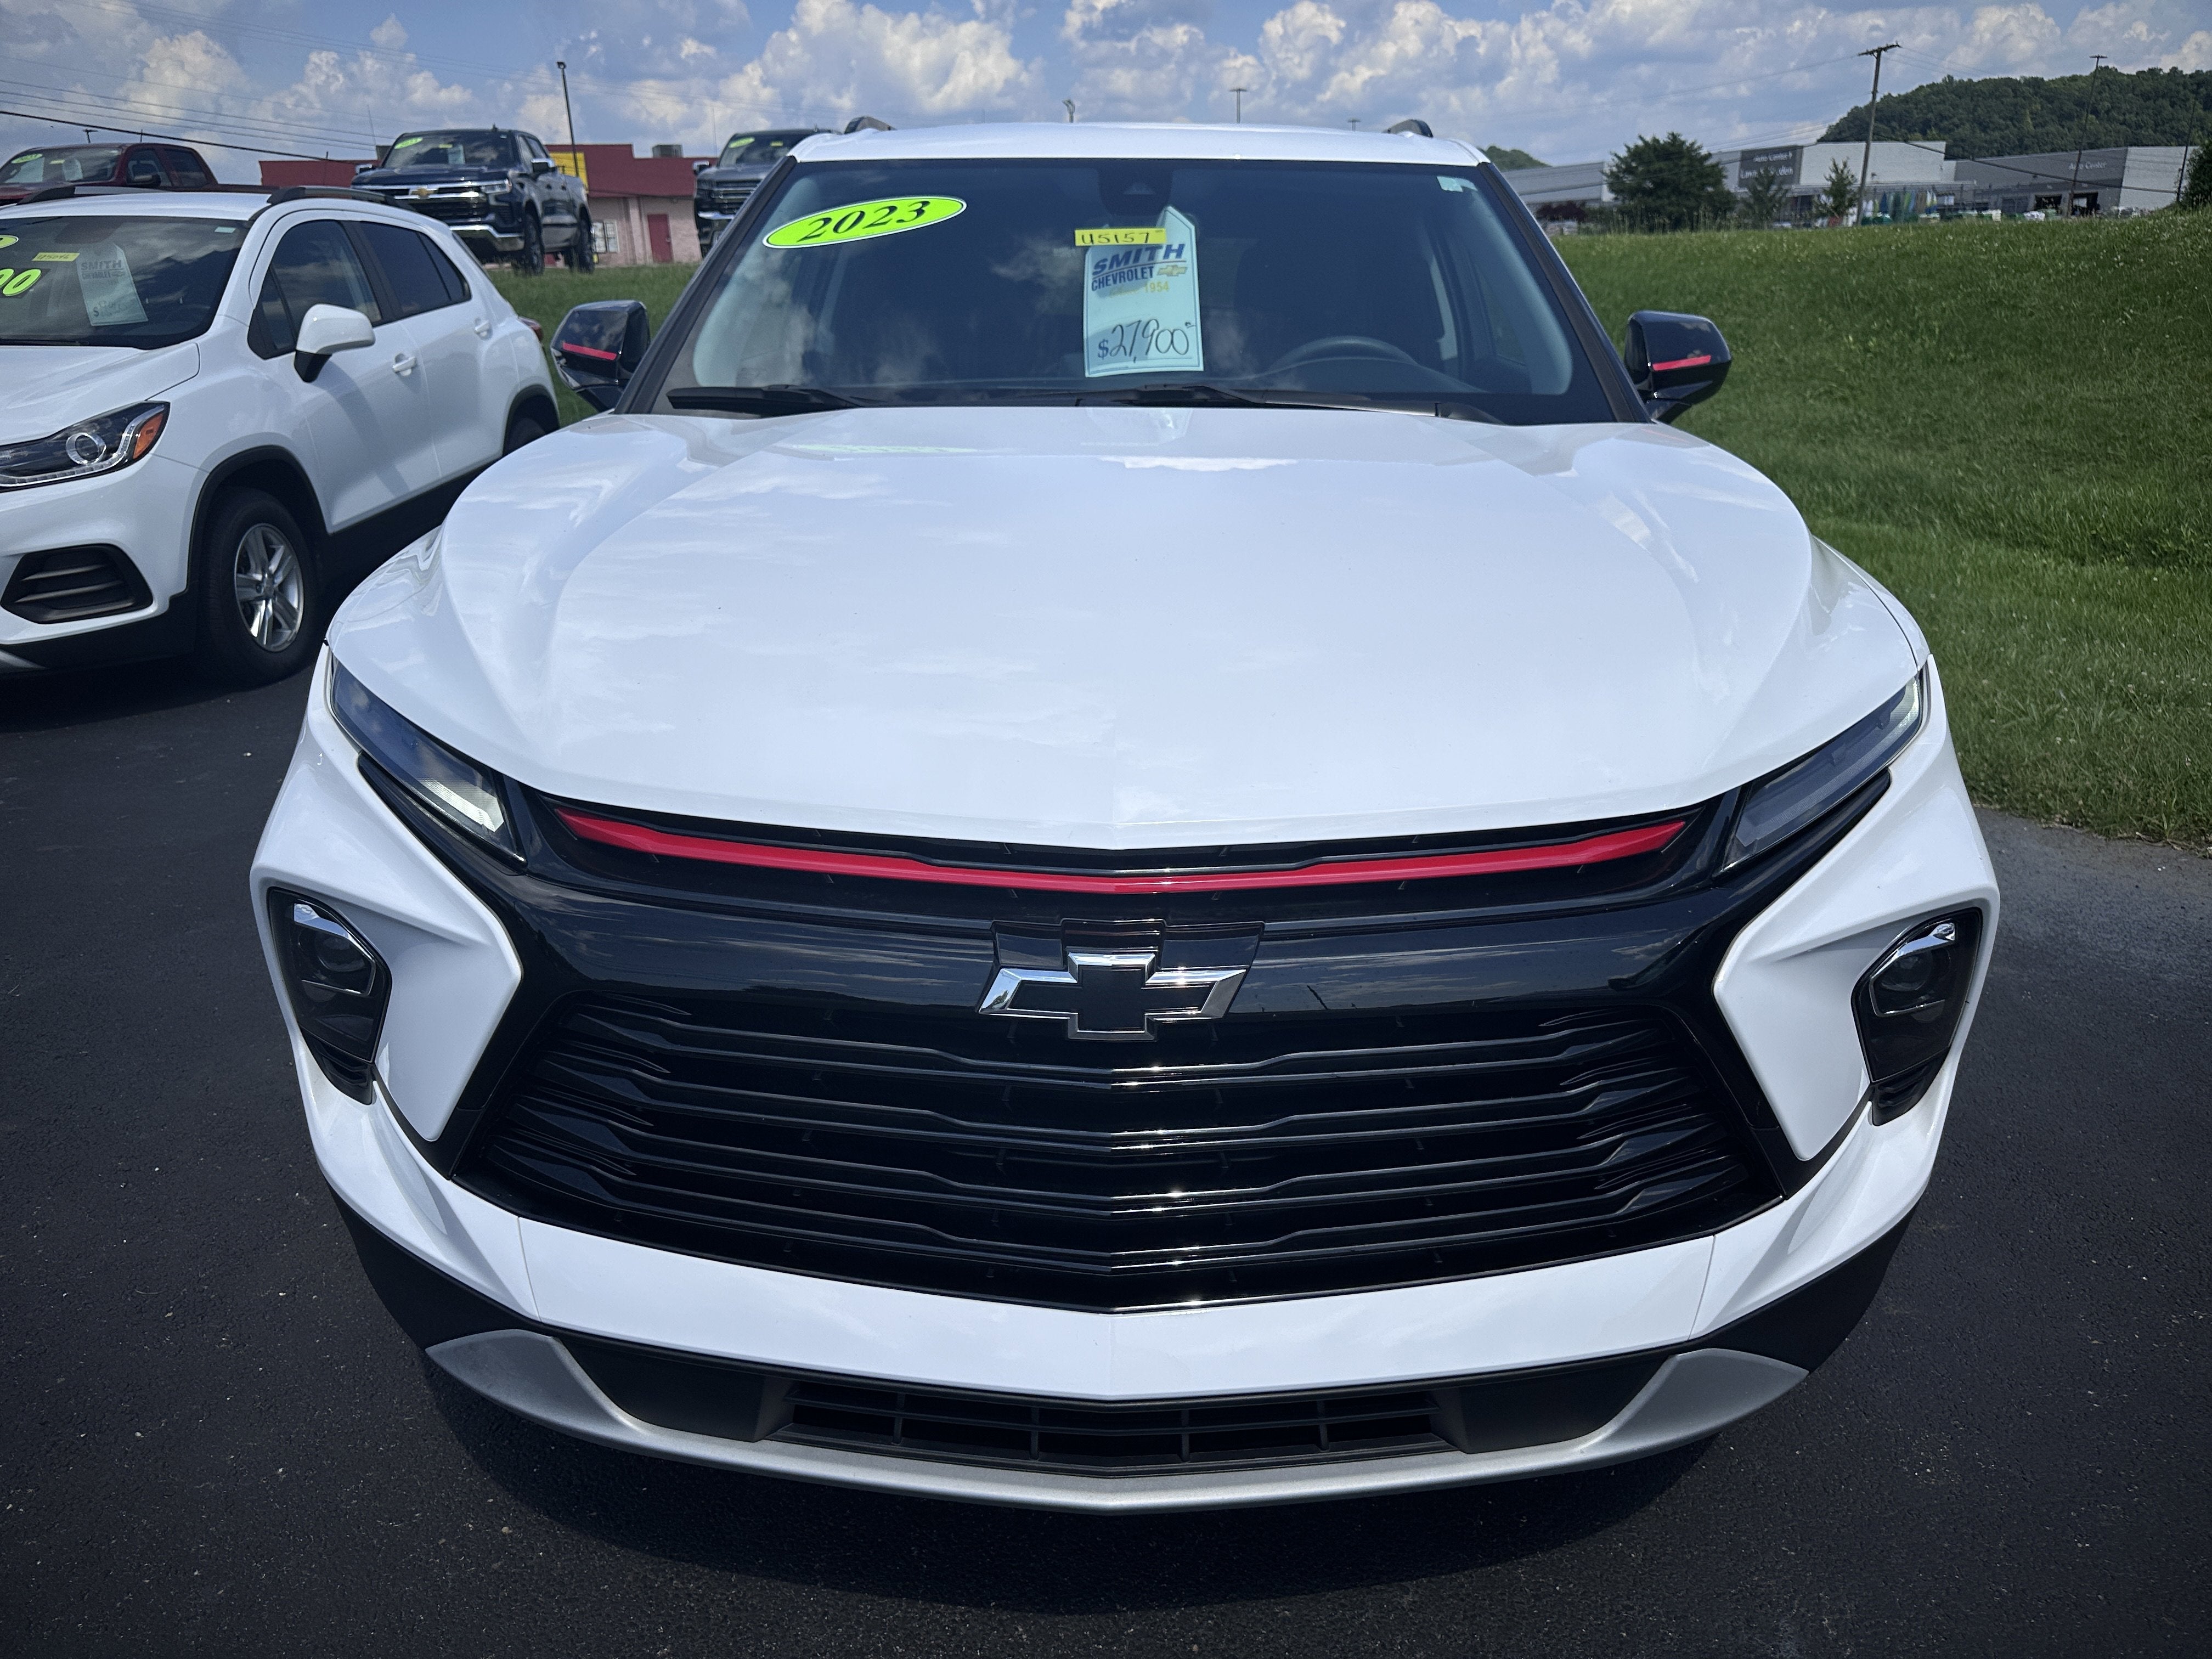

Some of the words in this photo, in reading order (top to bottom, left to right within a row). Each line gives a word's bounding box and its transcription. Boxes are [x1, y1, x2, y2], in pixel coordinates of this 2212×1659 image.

[795, 200, 931, 243] 2023
[1081, 232, 1150, 245] U5157
[81, 259, 122, 271] SMITH
[1092, 244, 1186, 276] SMITH
[1091, 266, 1154, 292] CHEVROLET
[1144, 280, 1170, 294] 1954
